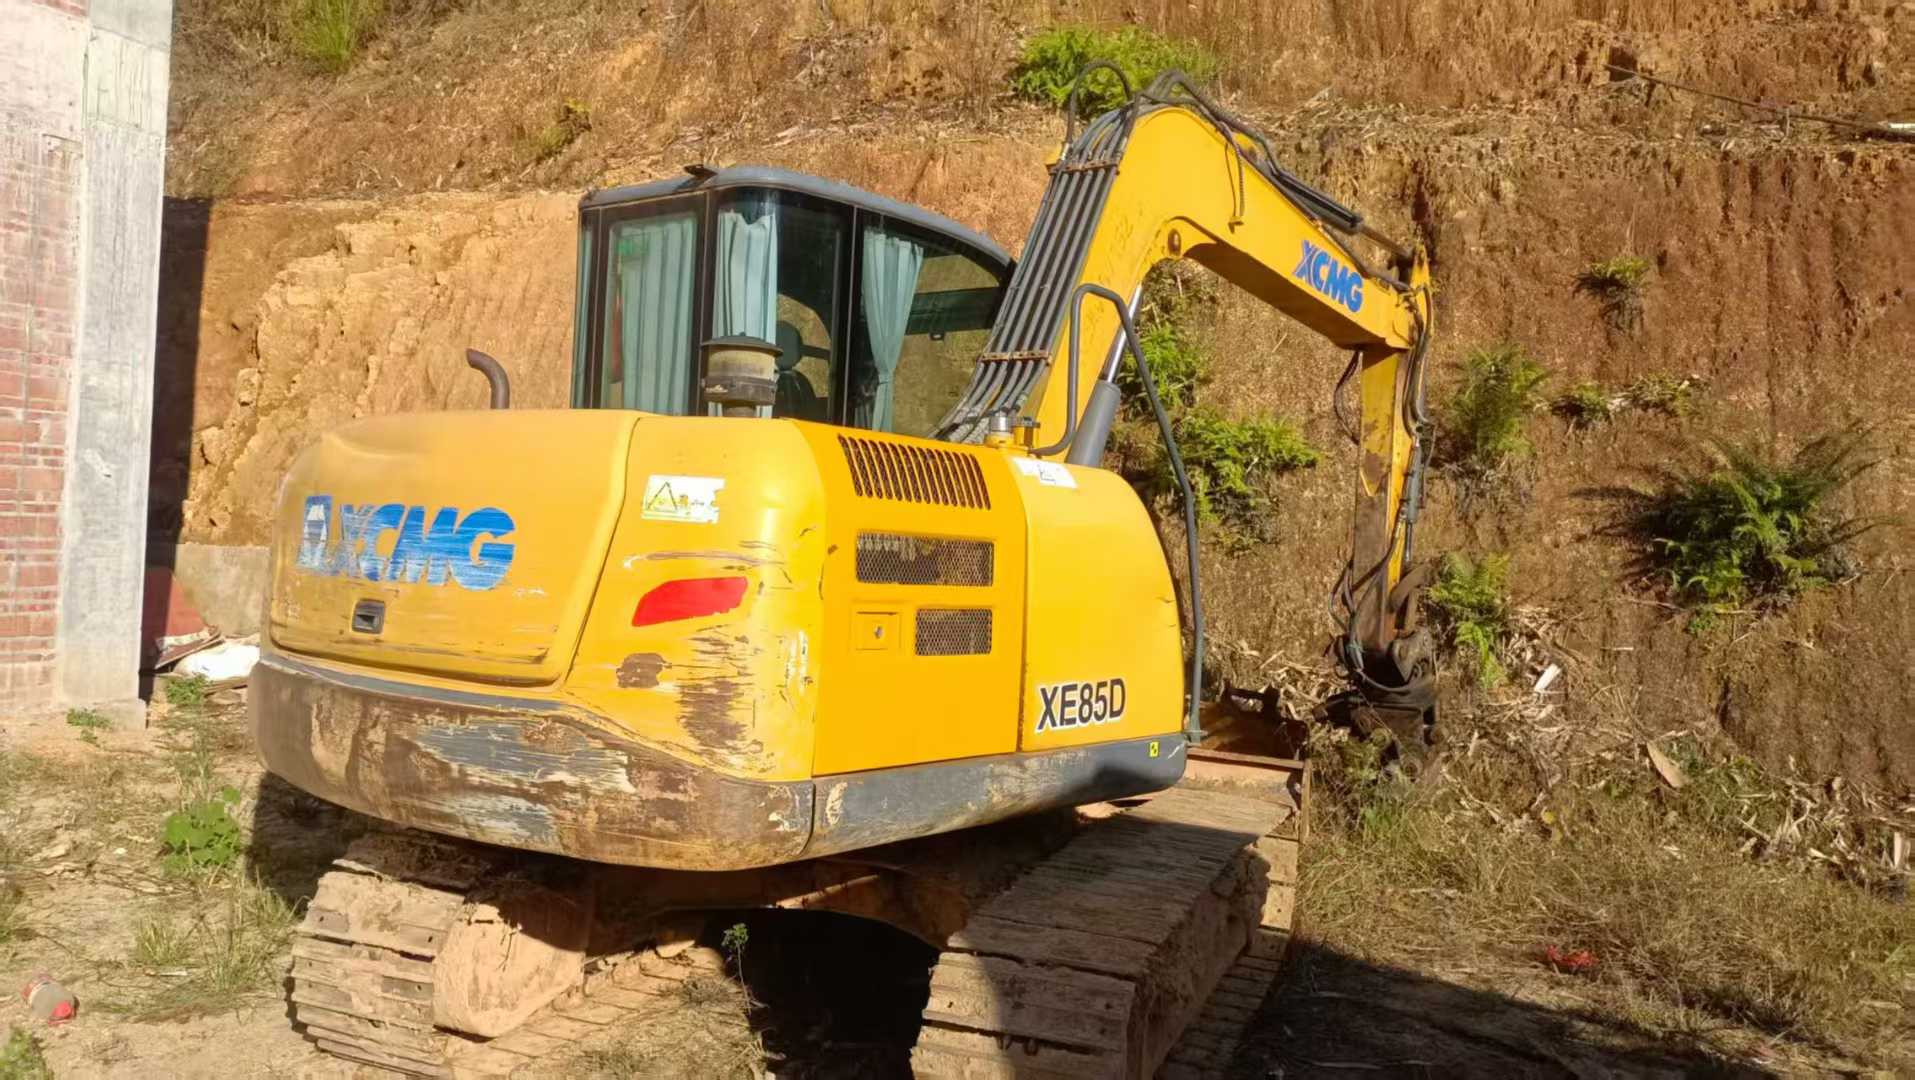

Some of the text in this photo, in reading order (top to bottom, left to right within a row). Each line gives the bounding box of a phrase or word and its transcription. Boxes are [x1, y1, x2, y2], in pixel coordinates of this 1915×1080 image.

[1294, 239, 1363, 313] XCMG
[332, 503, 516, 591] XCMG
[1036, 677, 1126, 731] XE85D
